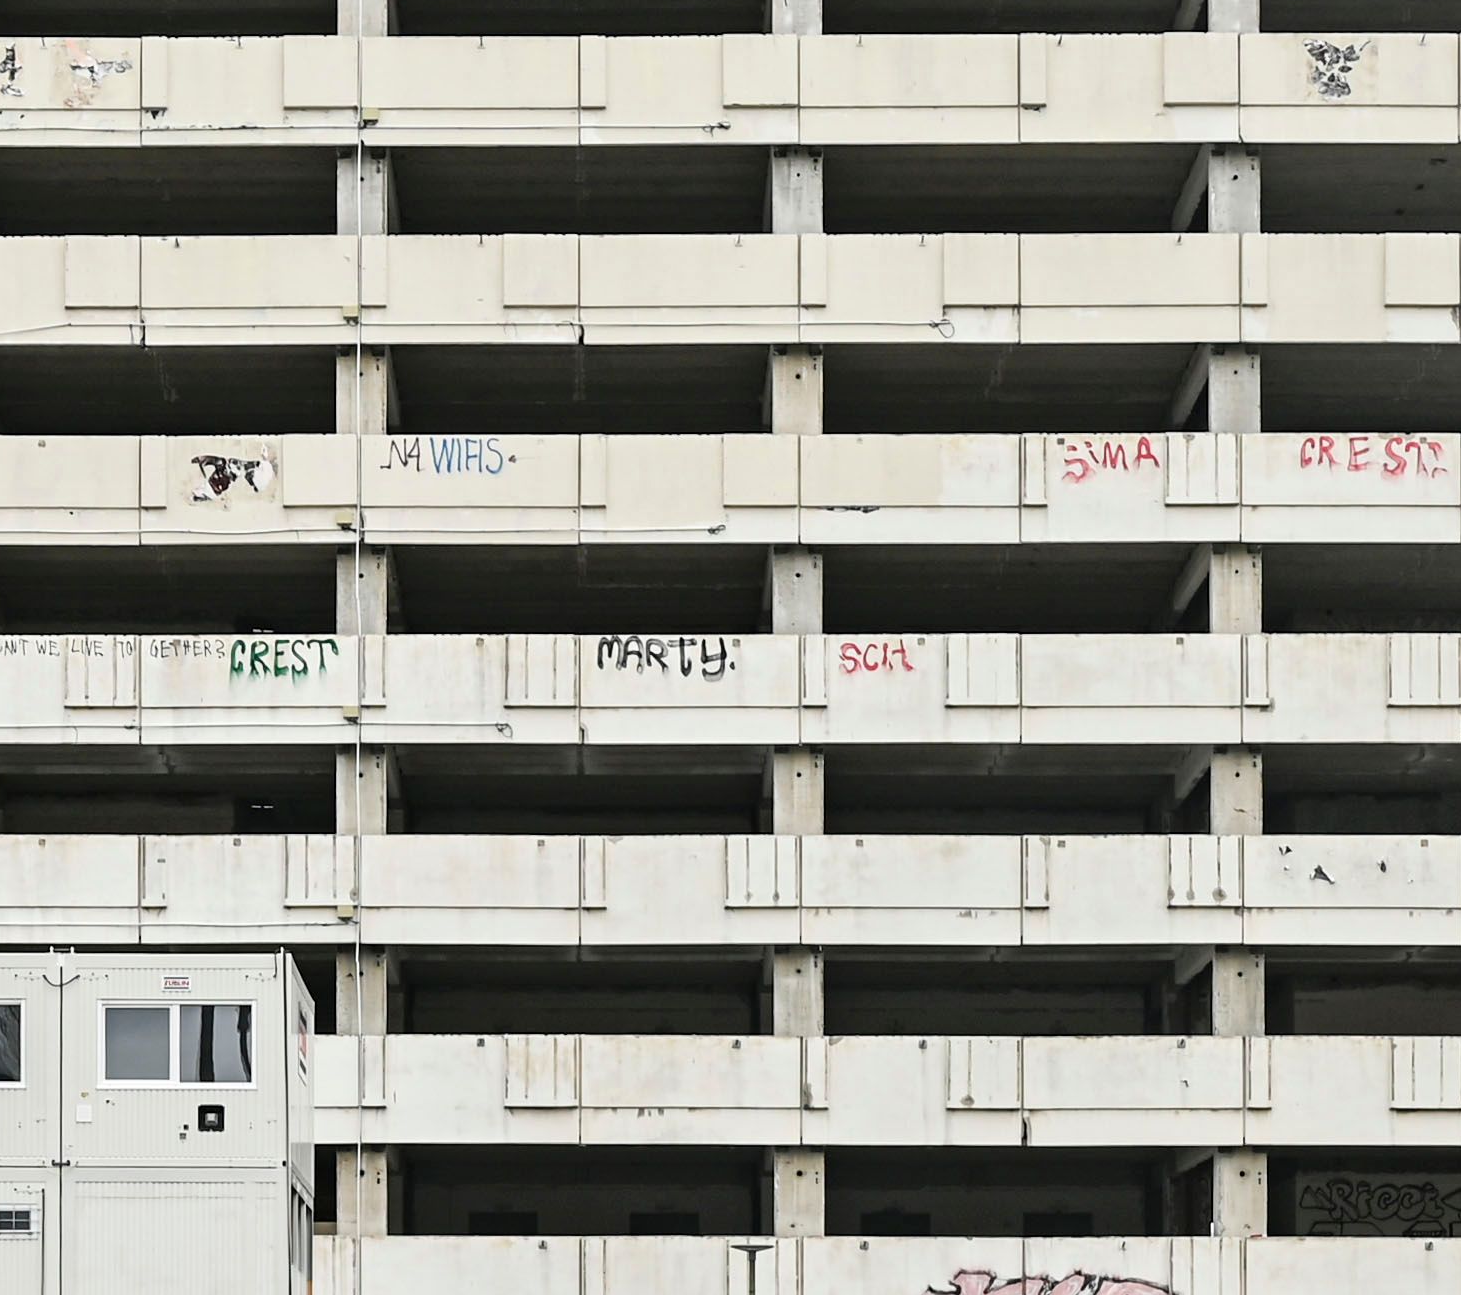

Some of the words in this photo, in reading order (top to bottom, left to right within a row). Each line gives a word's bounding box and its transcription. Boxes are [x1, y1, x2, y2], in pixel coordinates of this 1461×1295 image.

[36, 639, 60, 656] WE
[71, 639, 104, 656] LIVE
[230, 639, 339, 679] CREST
